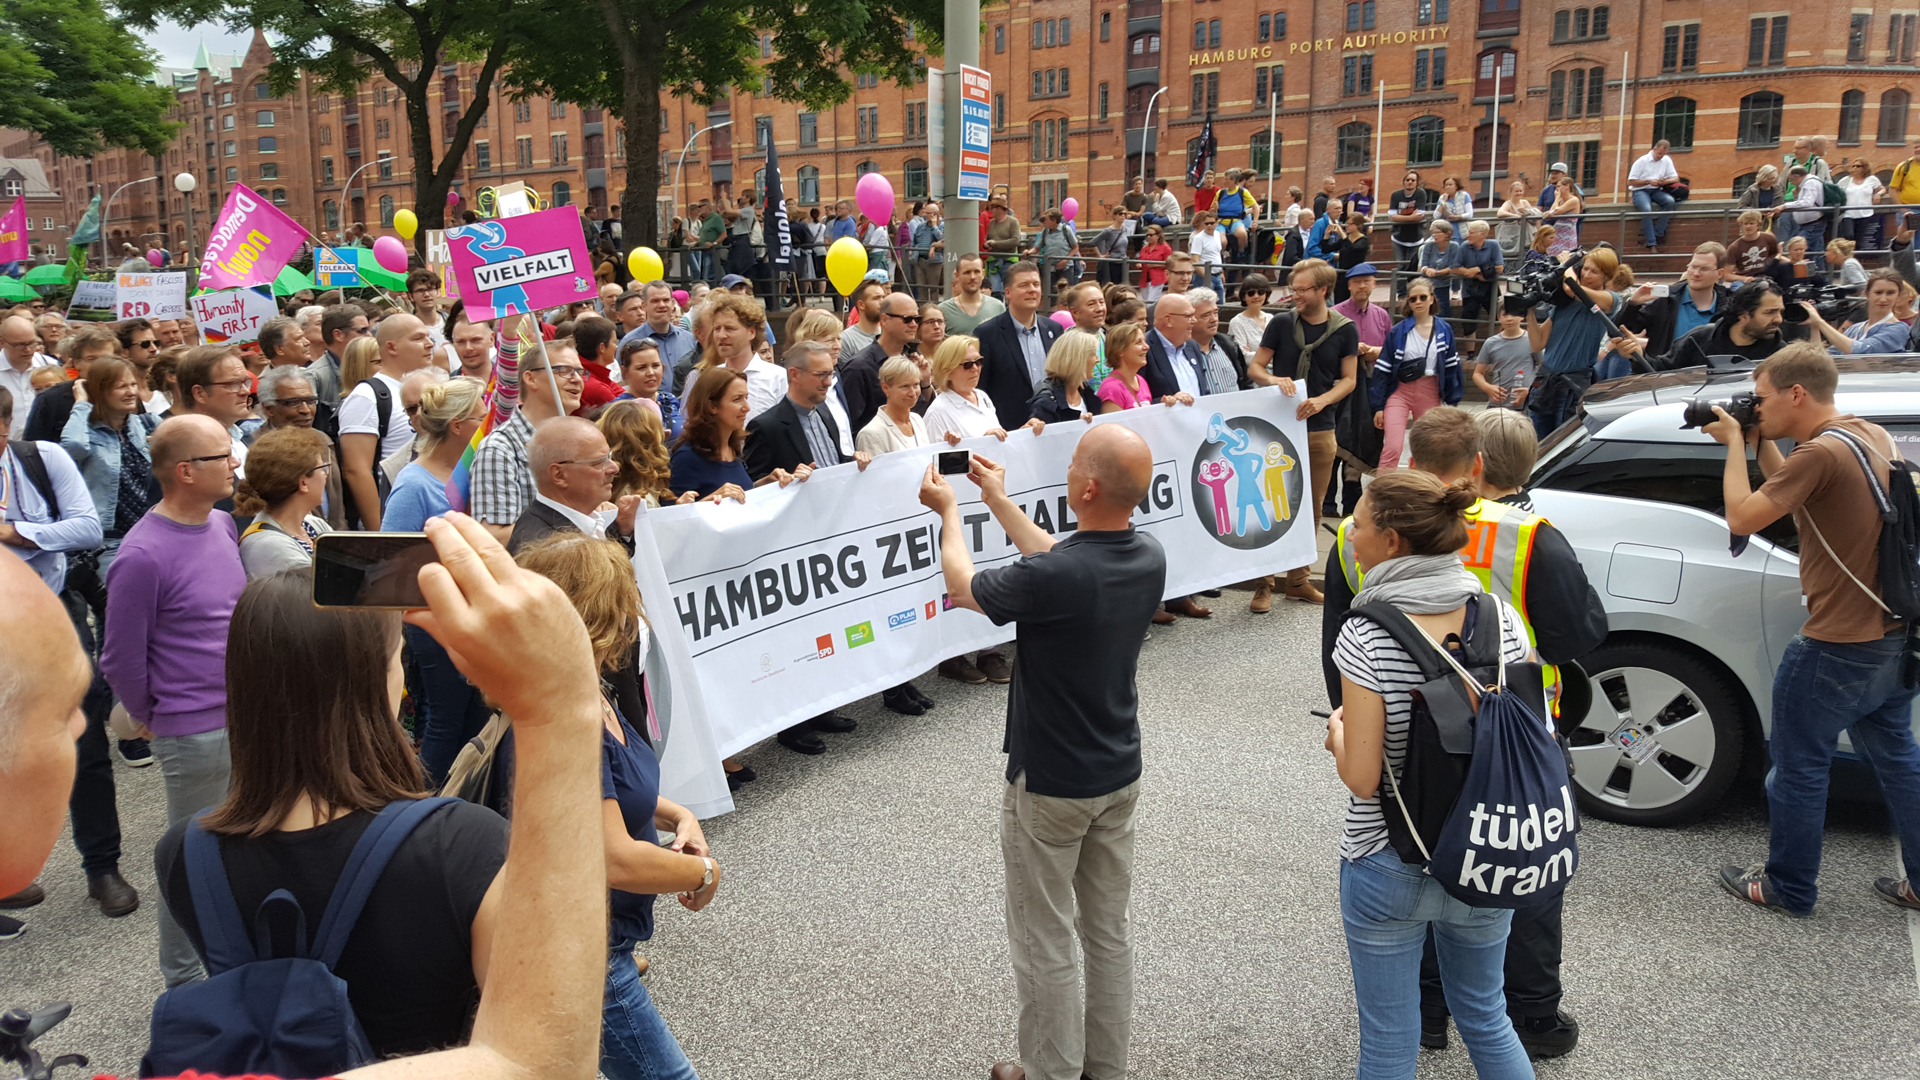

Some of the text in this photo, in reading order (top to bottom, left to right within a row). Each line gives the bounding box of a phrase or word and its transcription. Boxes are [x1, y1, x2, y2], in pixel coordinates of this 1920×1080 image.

[1189, 26, 1450, 66] HAMBURG PORT AUTHORITY
[477, 254, 568, 285] VIELFALT
[947, 252, 958, 262] 2A
[122, 302, 150, 318] RED
[194, 293, 245, 323] Humanity
[673, 544, 868, 642] HAMBURG
[875, 512, 990, 580] ZEIT
[899, 610, 916, 620] PLAN
[819, 646, 832, 658] SPD
[1469, 785, 1575, 852] tüdel
[1458, 847, 1573, 896] kram
